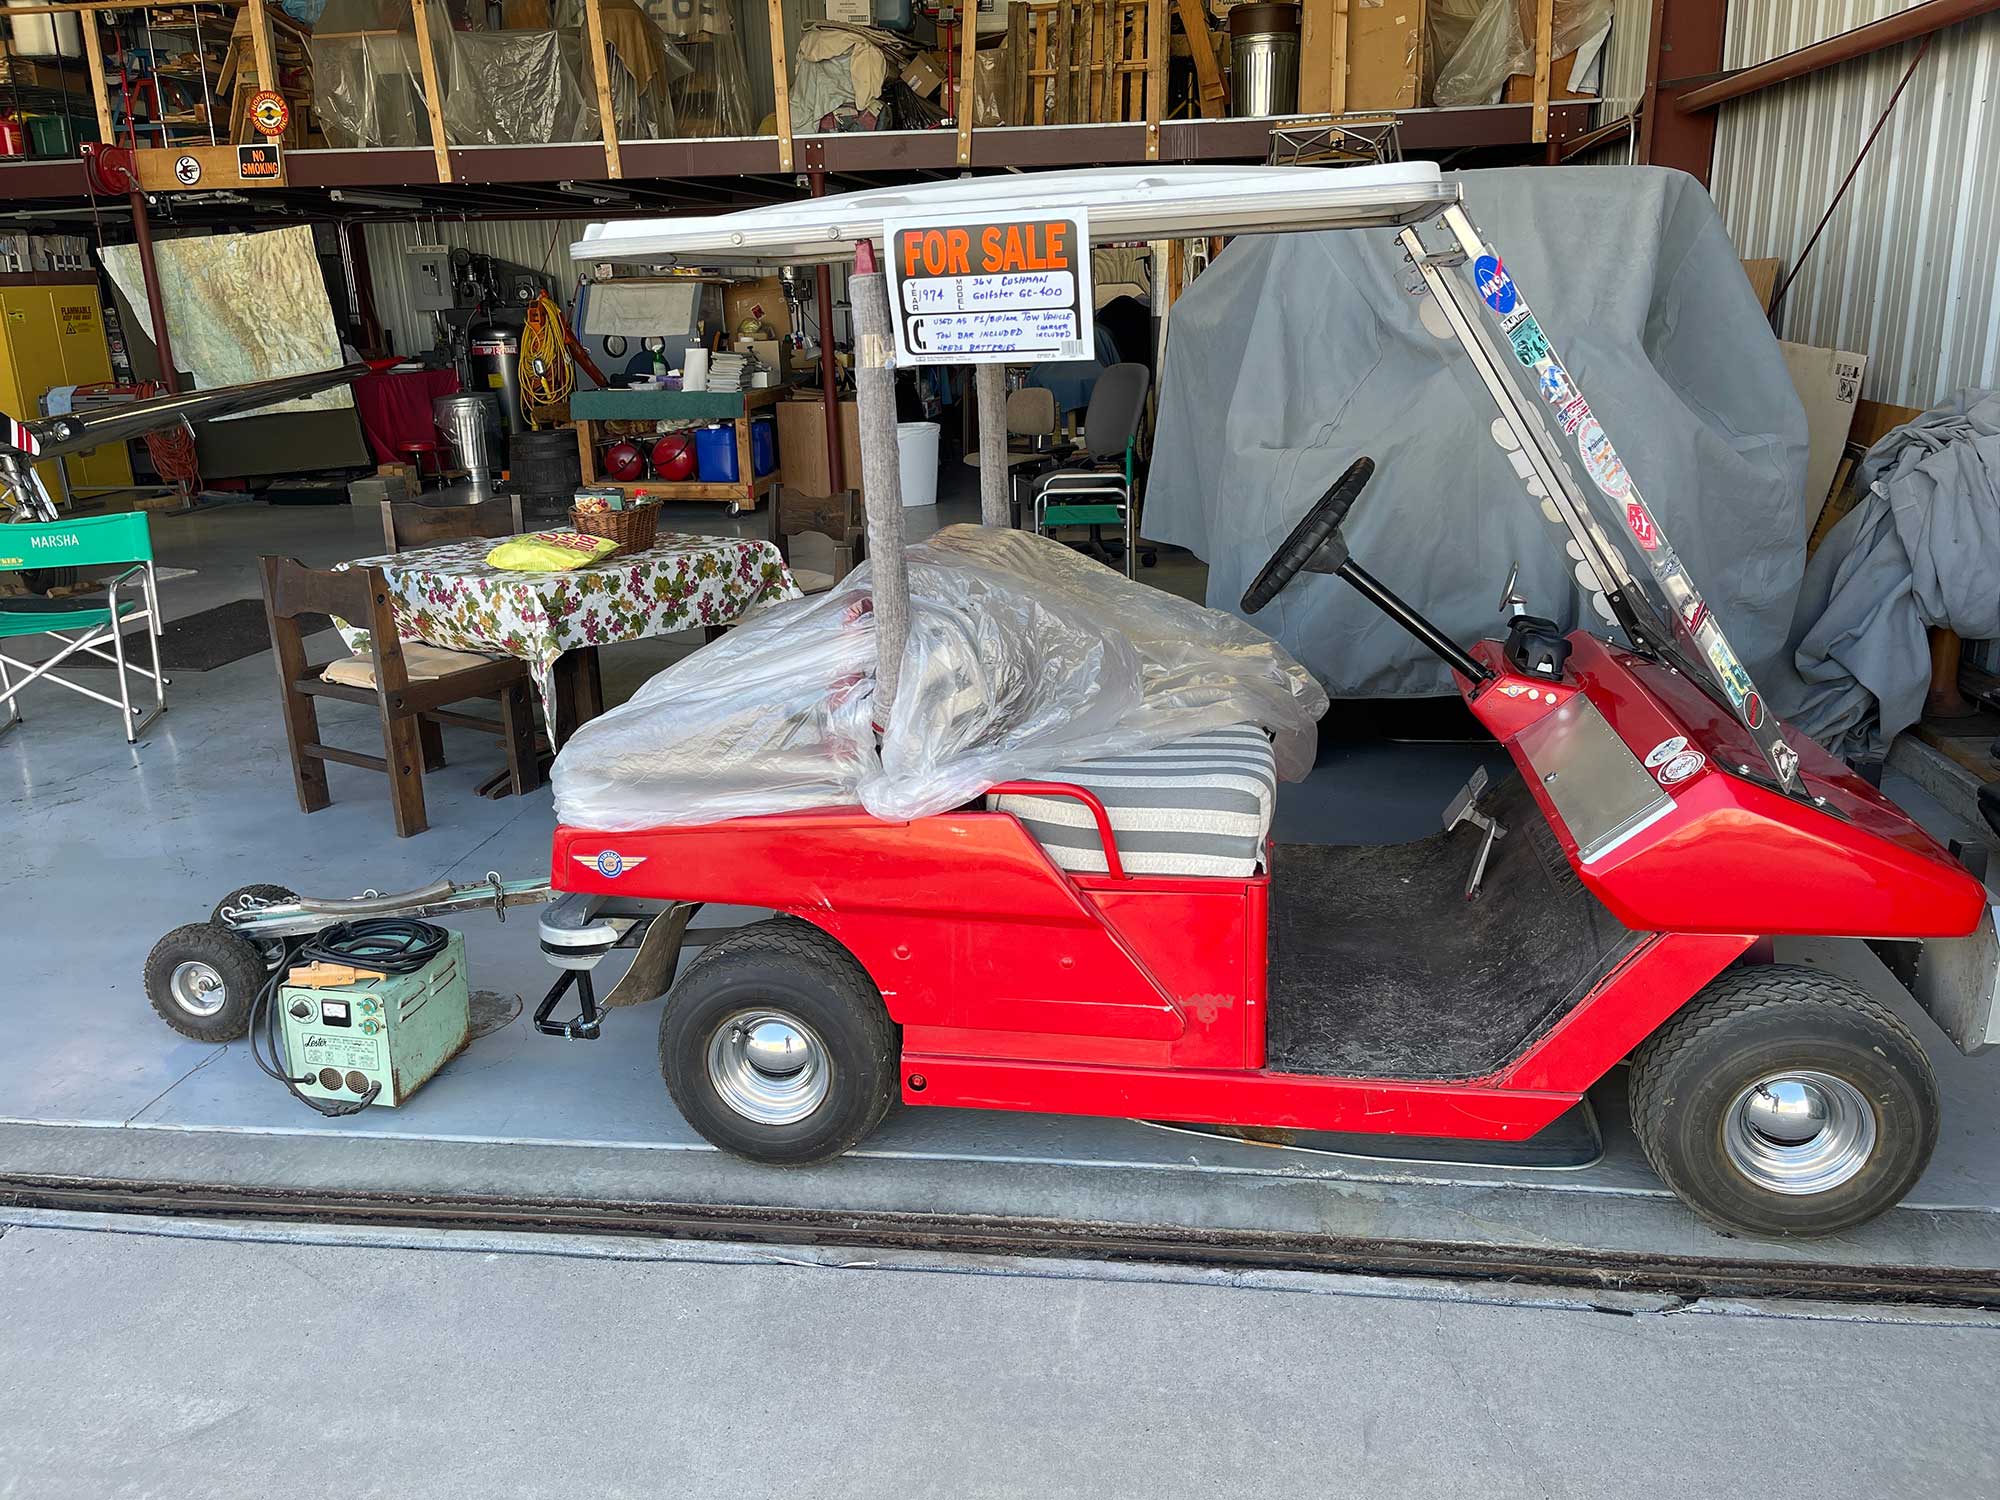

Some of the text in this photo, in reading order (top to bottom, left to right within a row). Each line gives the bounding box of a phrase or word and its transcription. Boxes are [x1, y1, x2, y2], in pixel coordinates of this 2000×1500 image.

[251, 92, 287, 110] NORTHWEST
[252, 116, 279, 135] AIRWAYS
[252, 150, 264, 162] NO
[242, 162, 278, 175] SMOKING
[903, 223, 1068, 276] FOR SALE
[1480, 271, 1511, 298] NASA
[910, 282, 919, 311] YEAR
[919, 289, 944, 302] 1974
[956, 279, 964, 310] MODEL
[1019, 286, 1063, 298] GC-400
[61, 306, 92, 315] FLAMMABLE
[956, 317, 967, 325] AS
[957, 331, 975, 340] BAR
[980, 328, 1023, 339] INCLUDED
[969, 343, 1017, 352] BATTERIES
[31, 534, 80, 549] MARSHA
